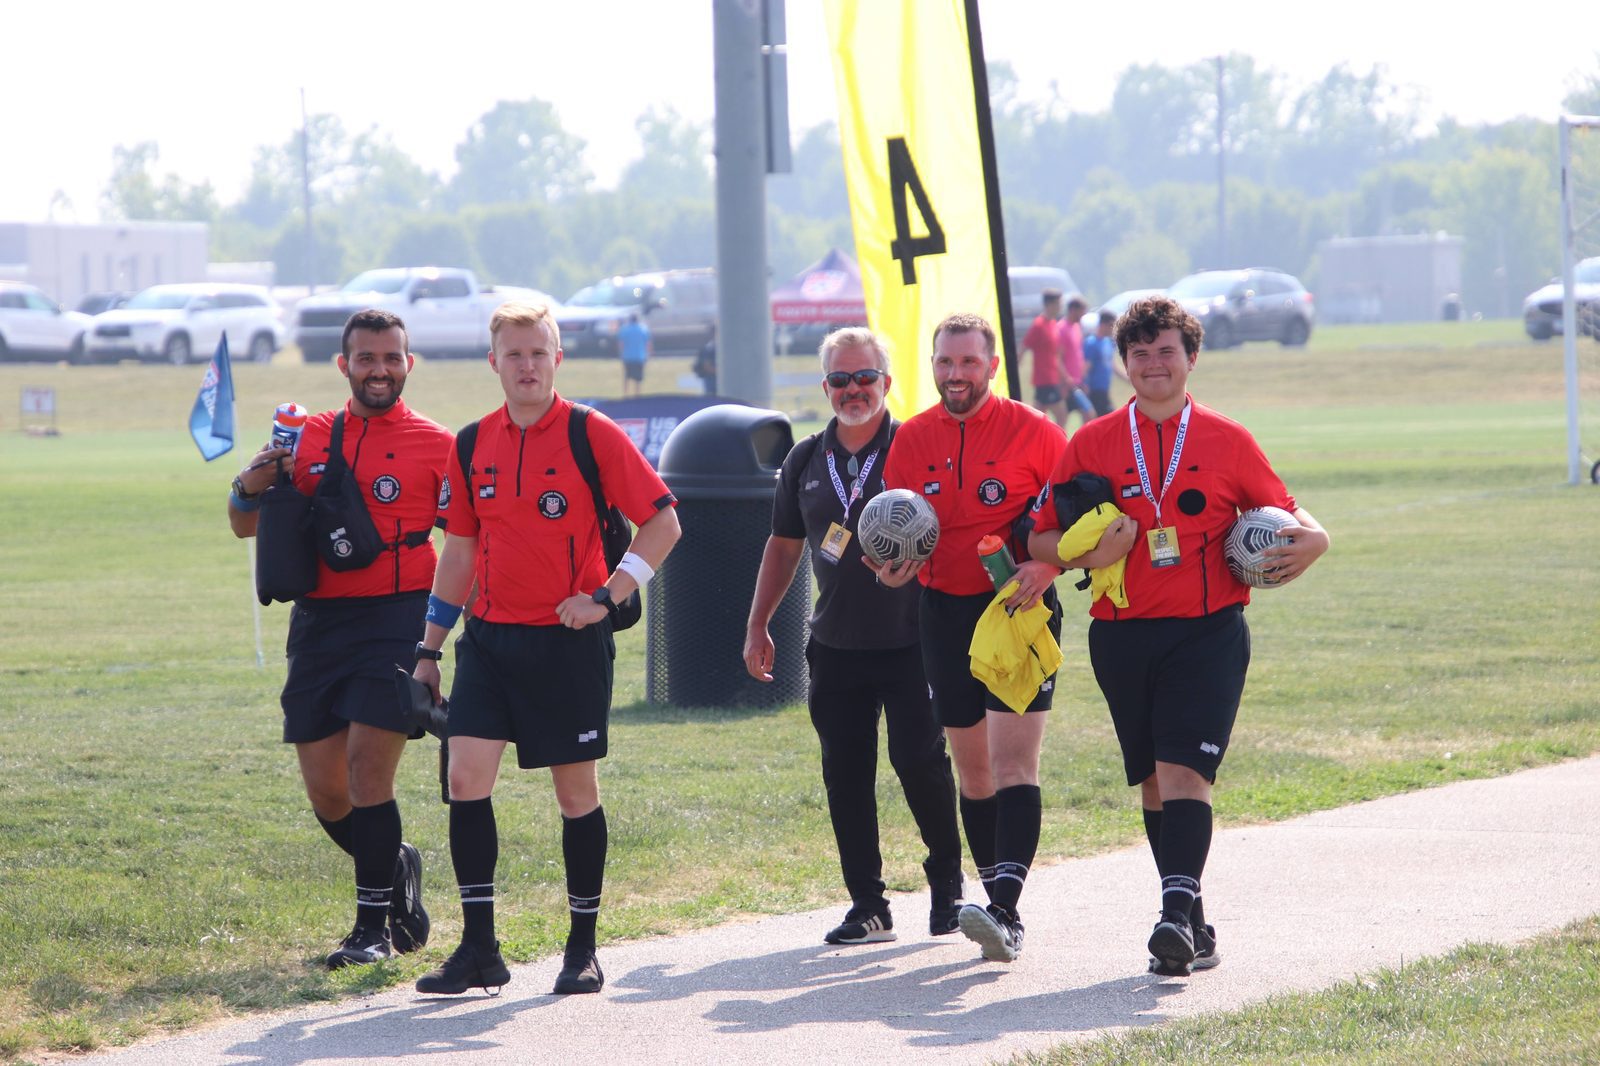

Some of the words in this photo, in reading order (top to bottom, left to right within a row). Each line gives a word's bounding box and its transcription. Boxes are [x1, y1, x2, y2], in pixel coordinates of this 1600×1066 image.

[887, 136, 947, 285] 4
[650, 417, 678, 430] US
[1134, 442, 1146, 471] YOUTH
[1166, 455, 1180, 484] YOUTH
[1173, 423, 1187, 456] SOCCER
